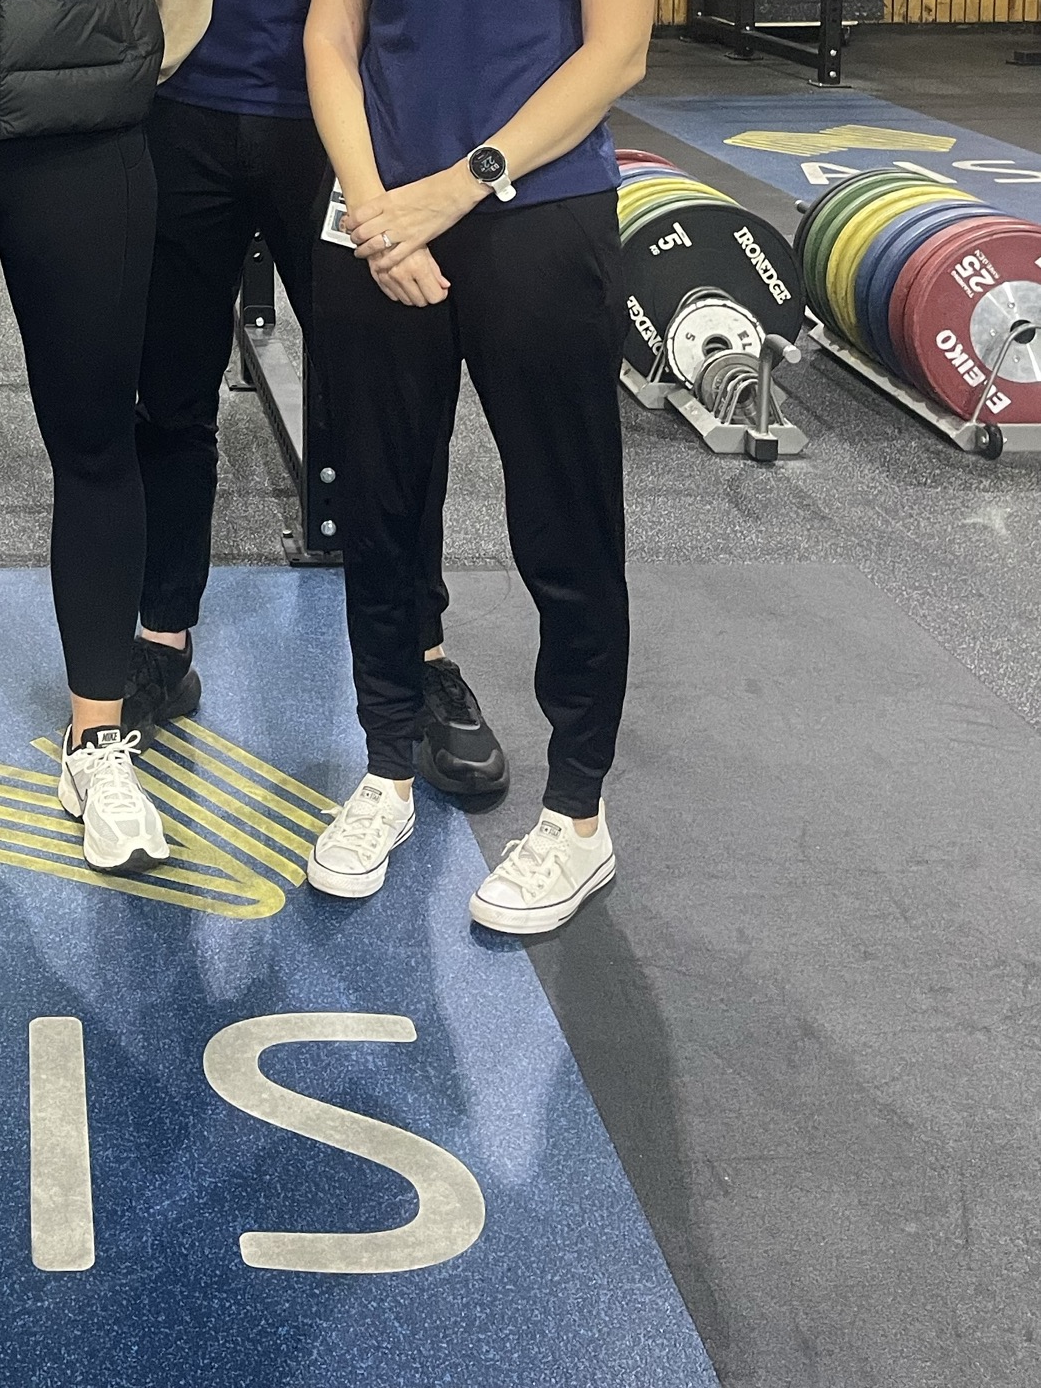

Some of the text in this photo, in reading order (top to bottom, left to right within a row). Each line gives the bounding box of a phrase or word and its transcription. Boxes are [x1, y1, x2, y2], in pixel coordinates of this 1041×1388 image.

[801, 160, 1041, 184] AIS
[658, 232, 683, 251] 5
[733, 226, 792, 305] IRONEDGE
[954, 255, 996, 293] 25
